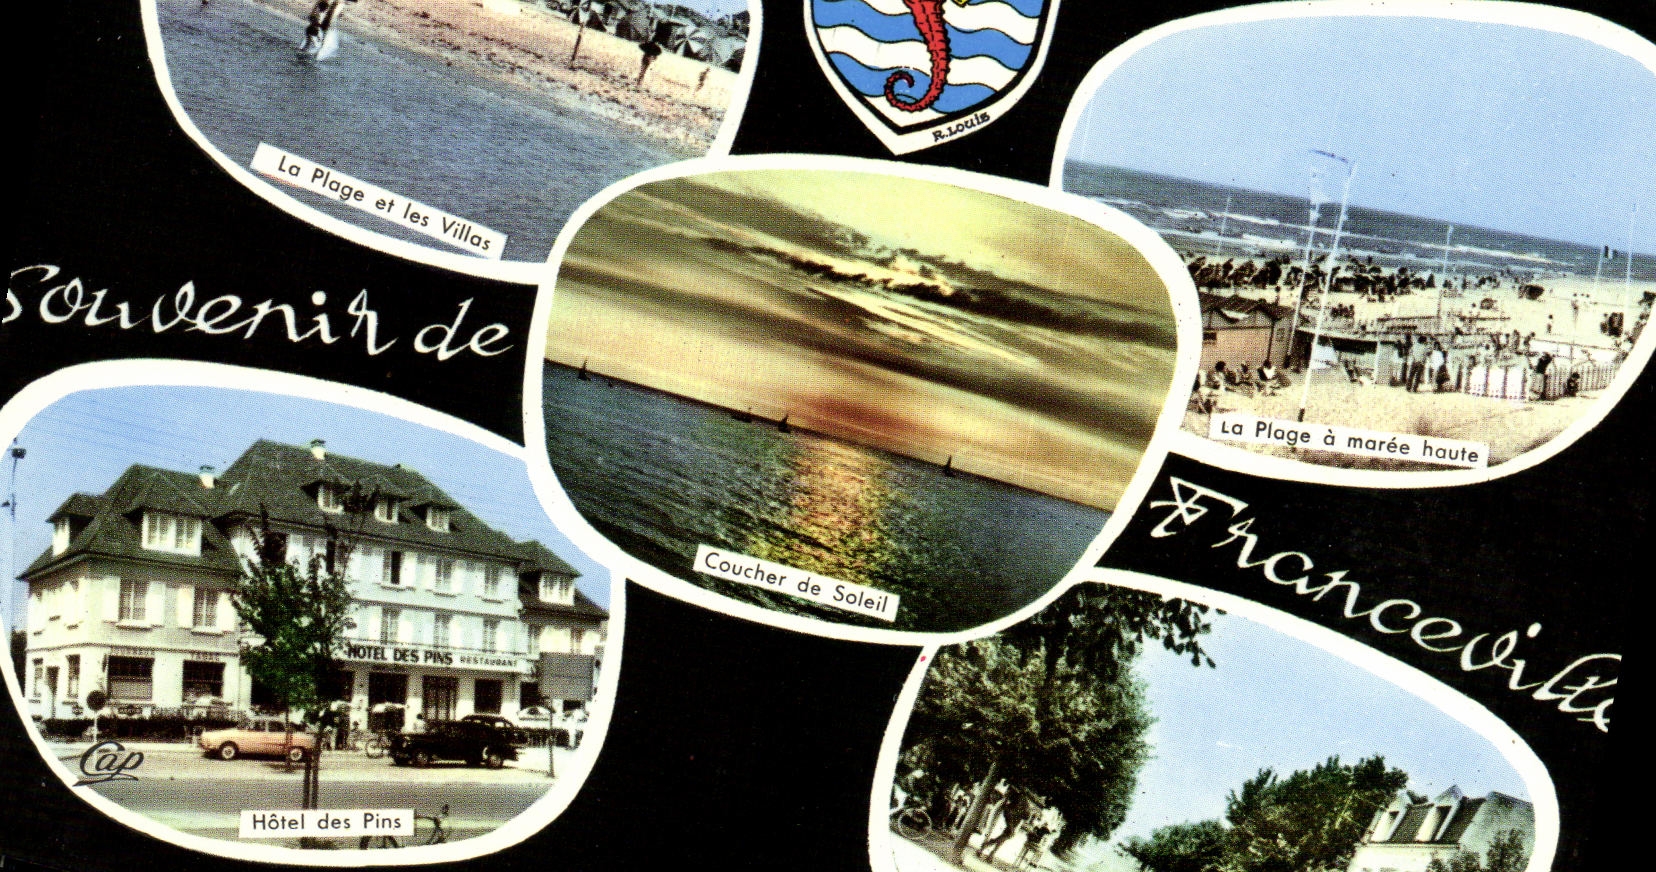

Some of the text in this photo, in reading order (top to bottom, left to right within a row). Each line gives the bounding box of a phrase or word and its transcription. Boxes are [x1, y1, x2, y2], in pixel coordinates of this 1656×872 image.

[1, 264, 514, 361] Souvenir de
[393, 649, 419, 664] DES
[424, 650, 453, 666] PINS
[460, 656, 518, 668] RESTAURANT
